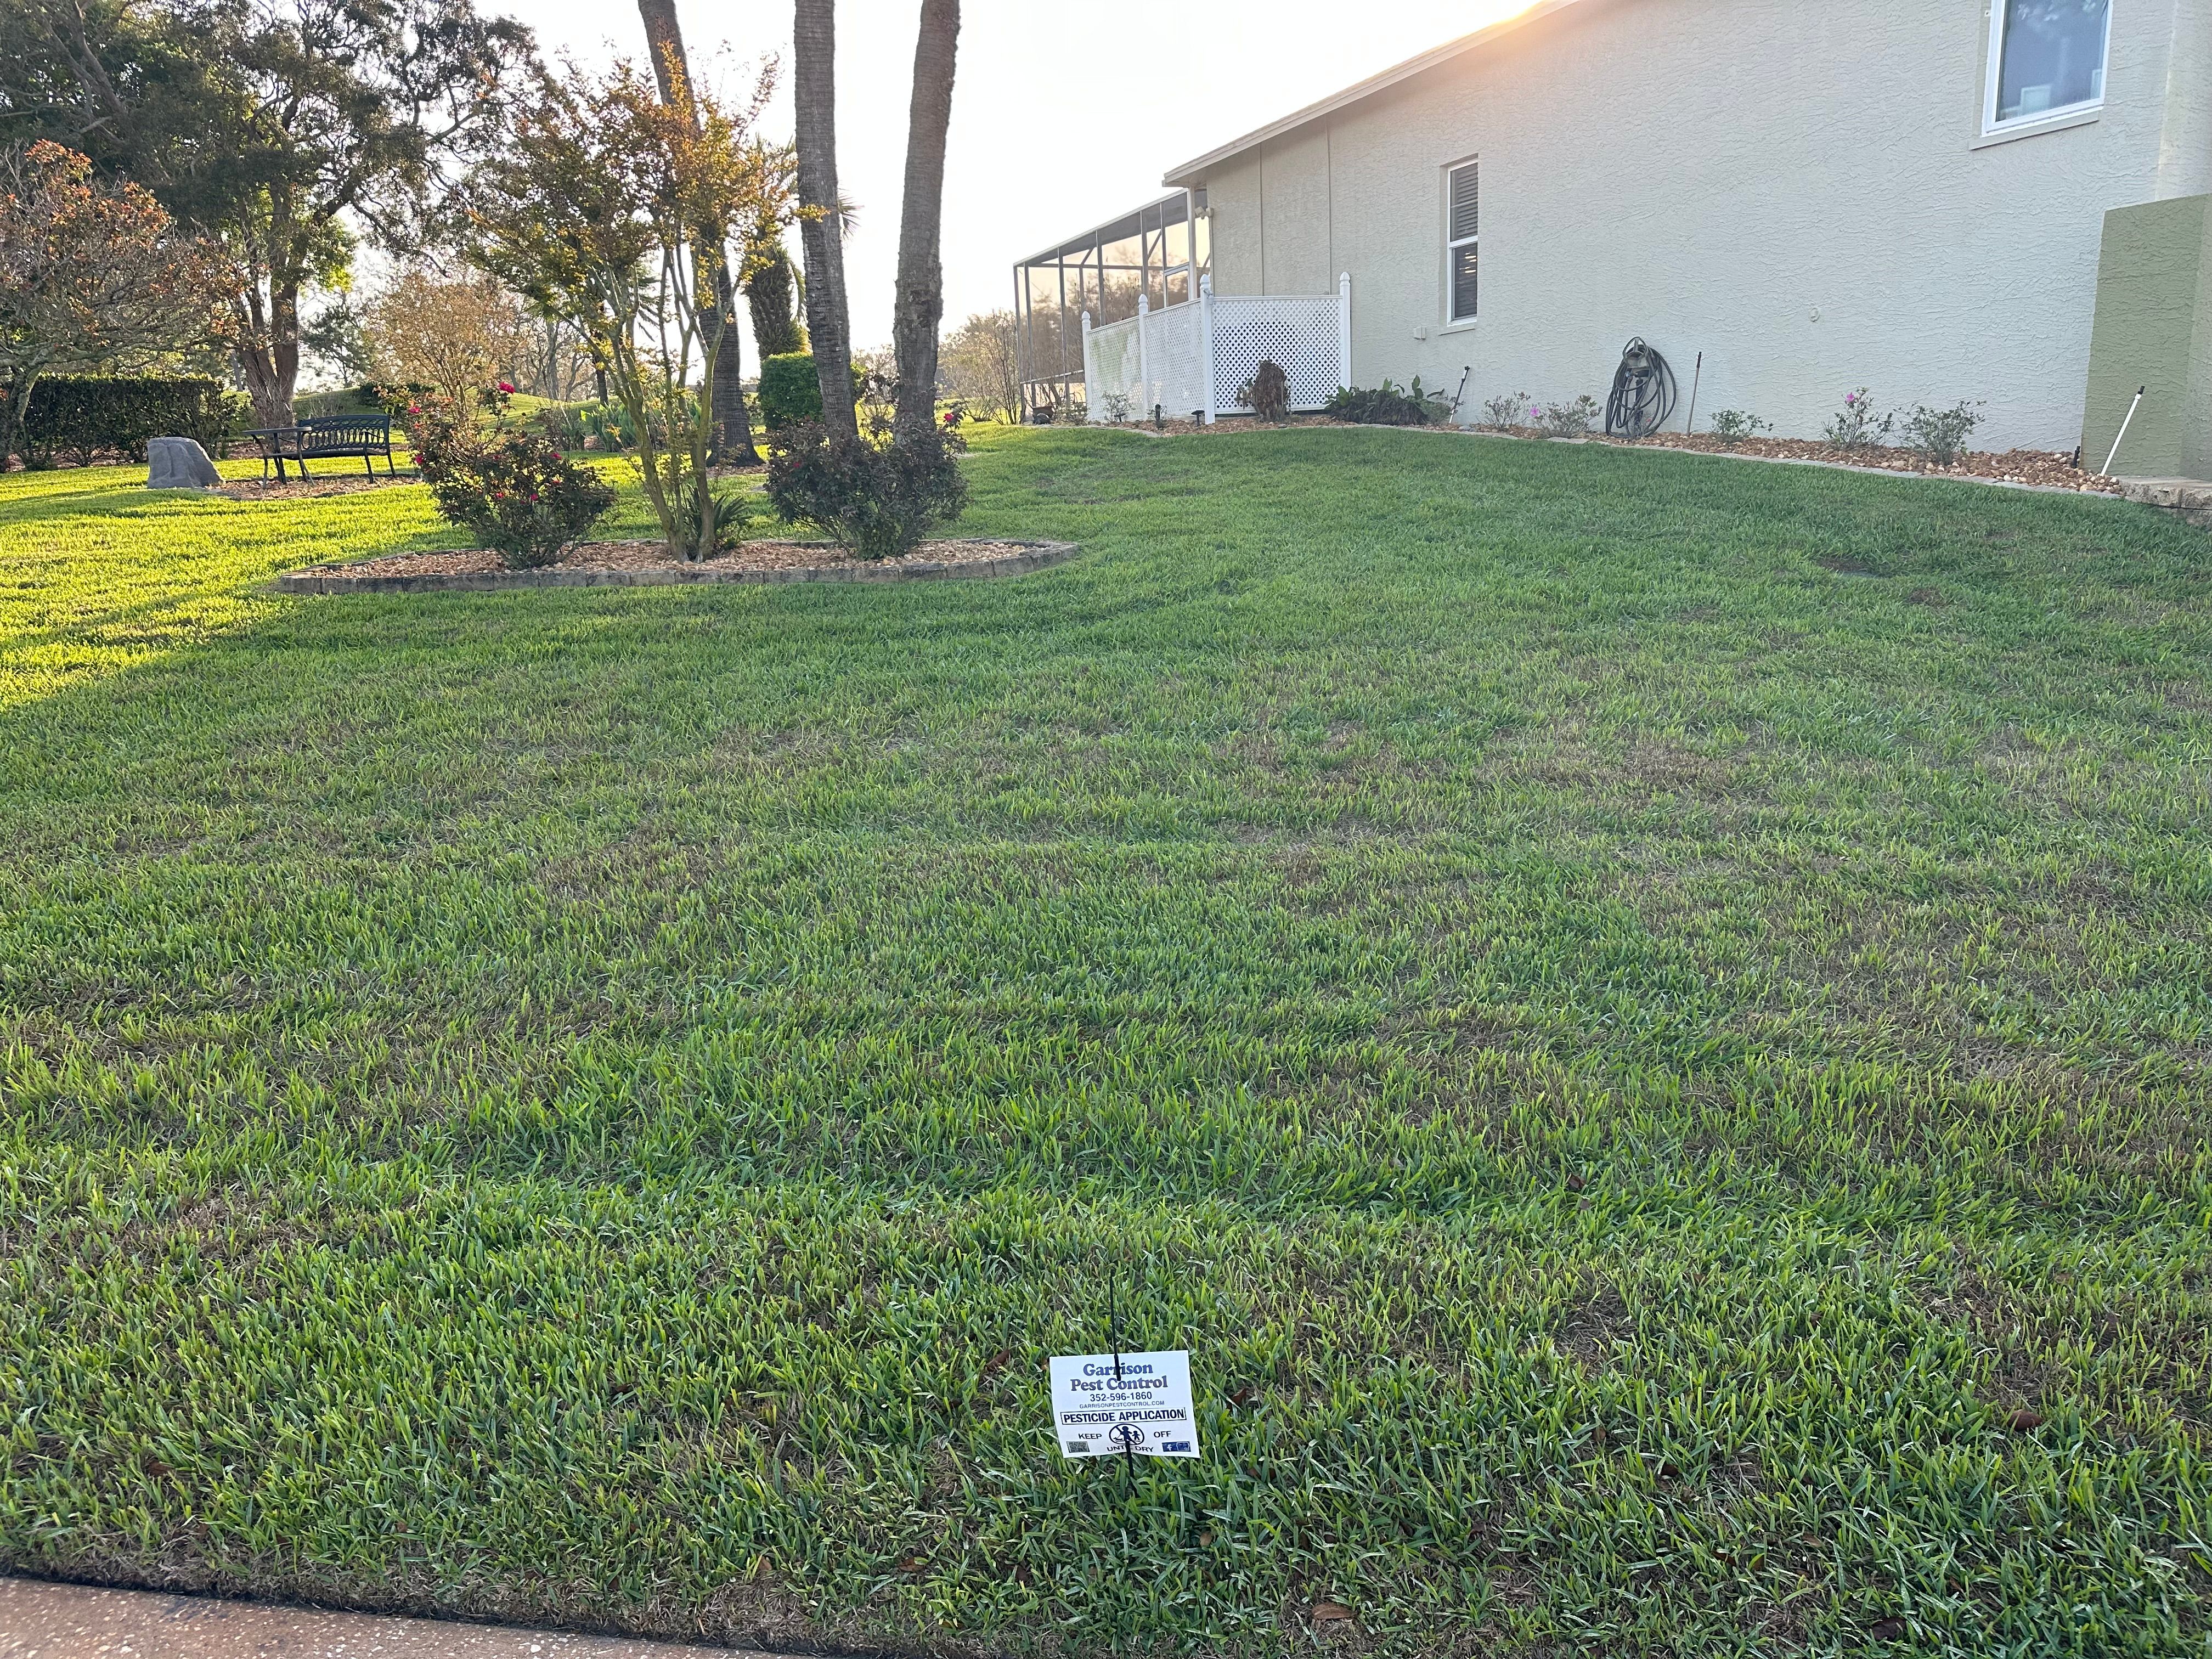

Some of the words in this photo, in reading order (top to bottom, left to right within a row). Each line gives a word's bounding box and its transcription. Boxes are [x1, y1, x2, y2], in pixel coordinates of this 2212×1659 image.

[1070, 1379, 1103, 1391] Pest
[1106, 1375, 1168, 1390] Control
[1090, 1391, 1152, 1402] 352-596-1860
[1079, 1400, 1165, 1409] GARRISONPESTCONTROL.COM
[1063, 1412, 1116, 1423] PESTICIDE
[1119, 1409, 1185, 1421] APPLICATION
